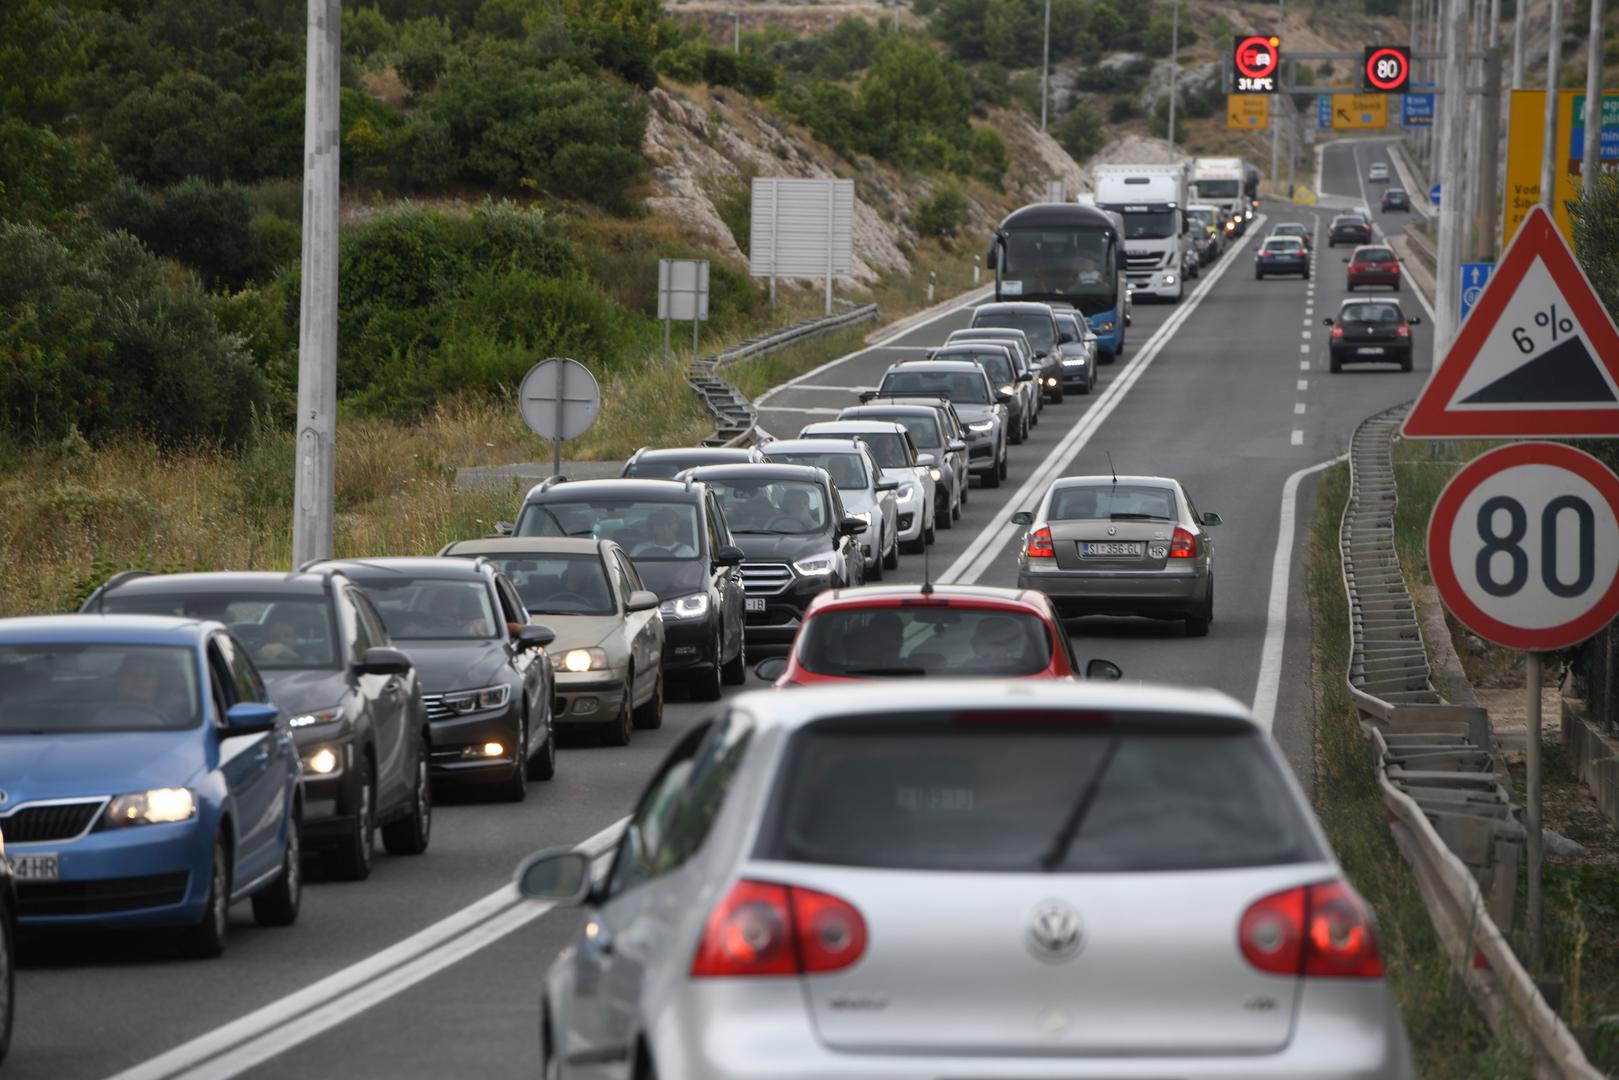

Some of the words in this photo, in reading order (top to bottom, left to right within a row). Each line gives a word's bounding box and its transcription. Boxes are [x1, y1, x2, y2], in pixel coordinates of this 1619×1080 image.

[1377, 59, 1398, 78] 80
[1151, 546, 1164, 557] HR
[1476, 495, 1595, 598] 80
